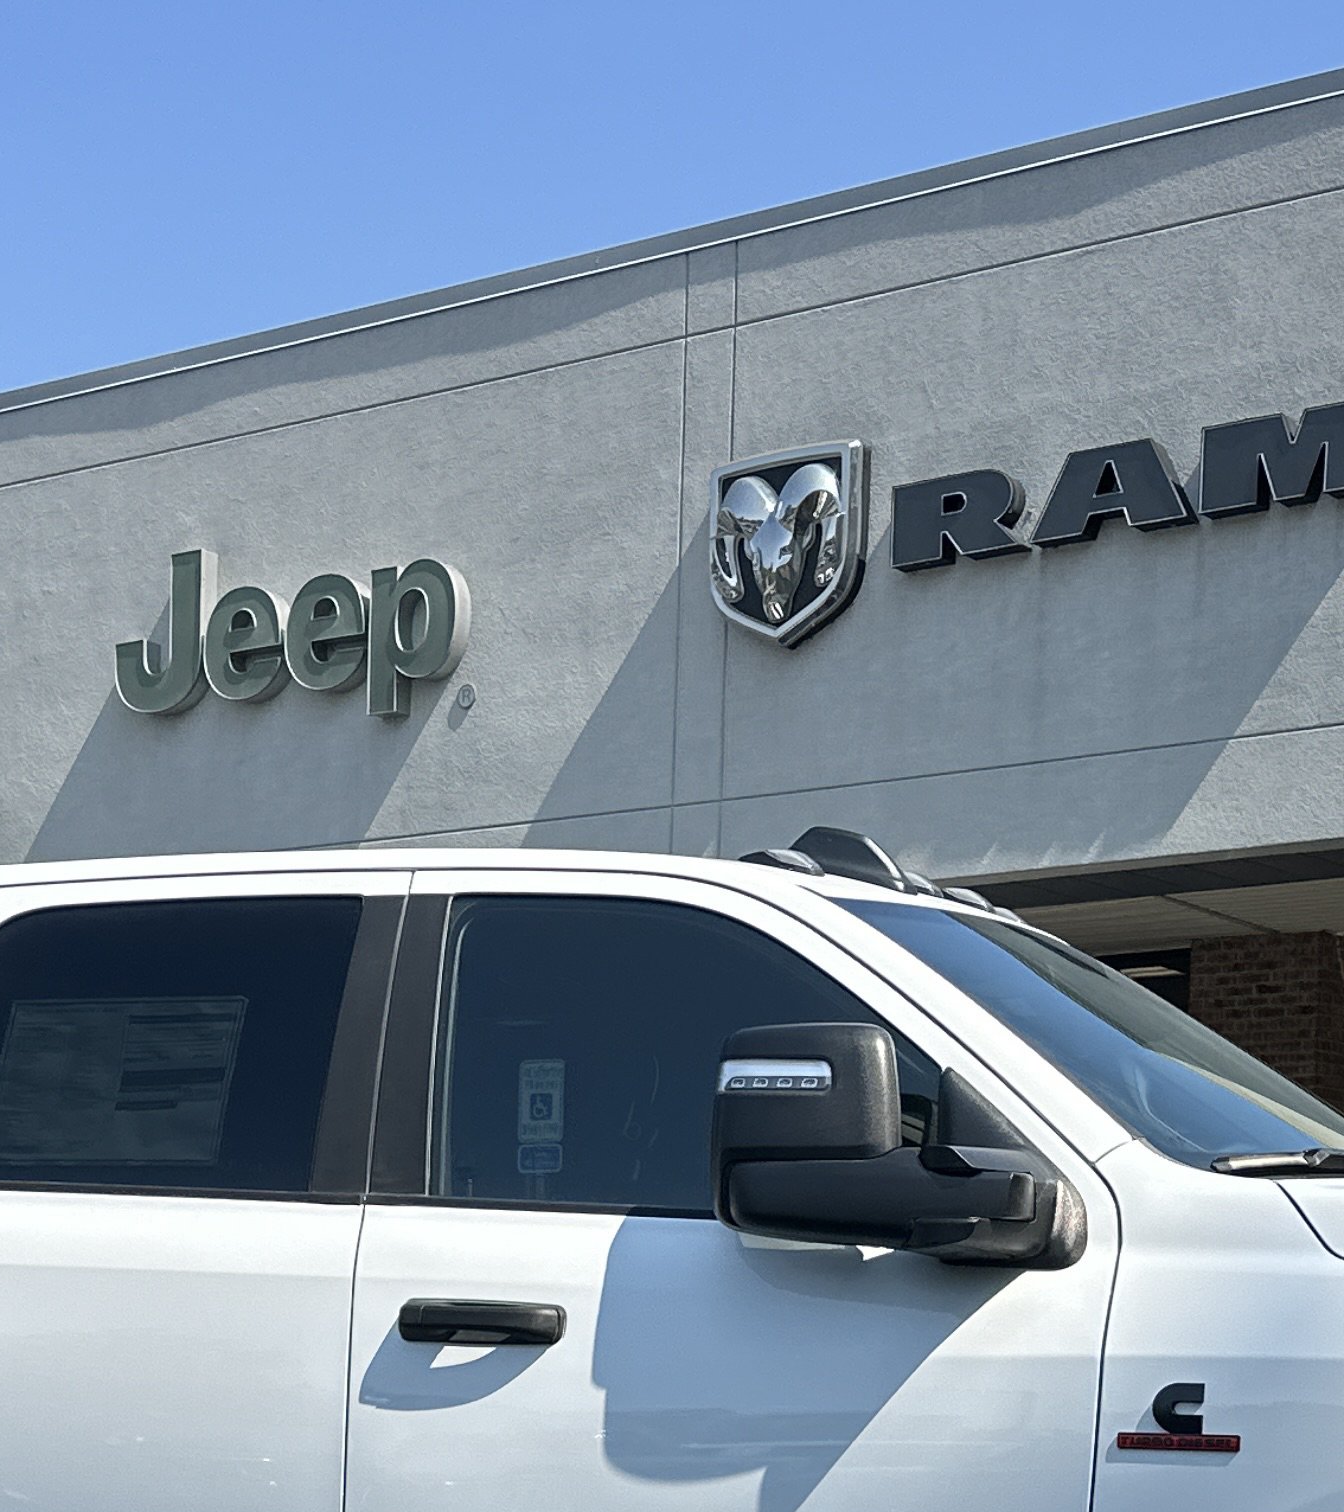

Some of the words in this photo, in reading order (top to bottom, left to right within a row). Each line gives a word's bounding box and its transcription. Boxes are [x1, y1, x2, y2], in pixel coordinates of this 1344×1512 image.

[115, 549, 471, 717] Jeep
[1120, 1436, 1174, 1448] TURBO
[1176, 1437, 1235, 1449] DIESEL
